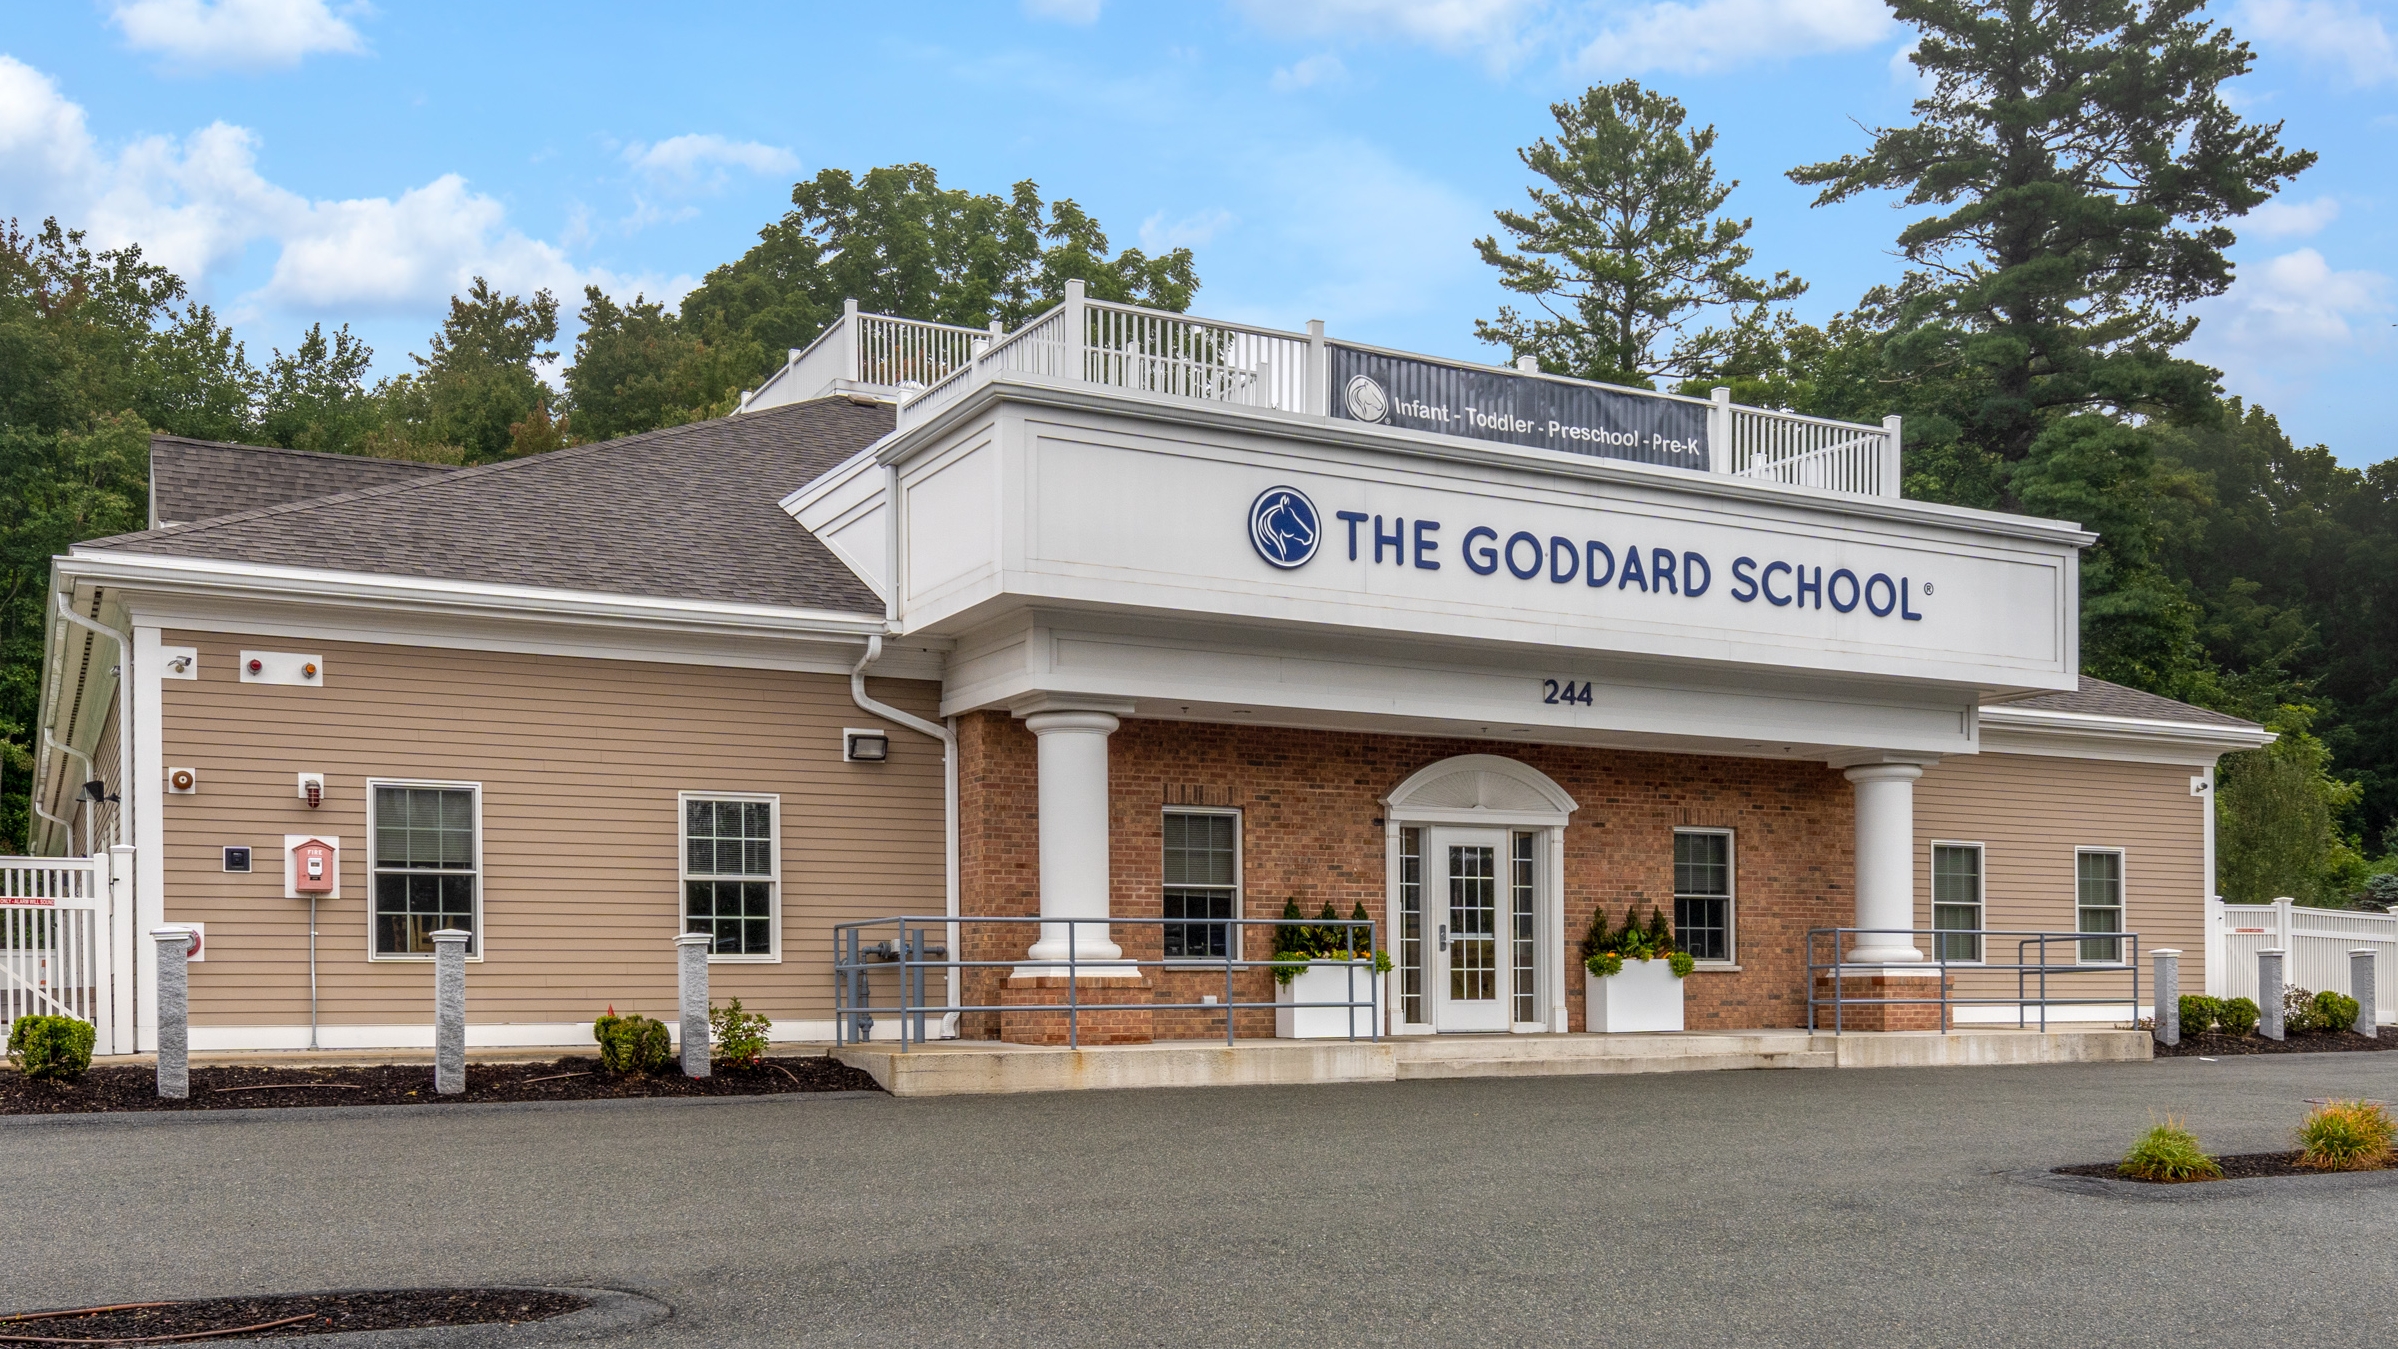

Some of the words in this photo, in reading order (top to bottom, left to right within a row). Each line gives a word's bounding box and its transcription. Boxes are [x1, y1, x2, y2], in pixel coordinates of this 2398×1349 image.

[1394, 396, 1450, 423] Infant
[1464, 406, 1535, 434] Toddler
[1548, 420, 1639, 448] Preschool
[1652, 432, 1700, 456] Pre-K
[1336, 510, 1441, 571] THE
[1462, 526, 1711, 598] GODDARD
[1544, 679, 1594, 707] 244
